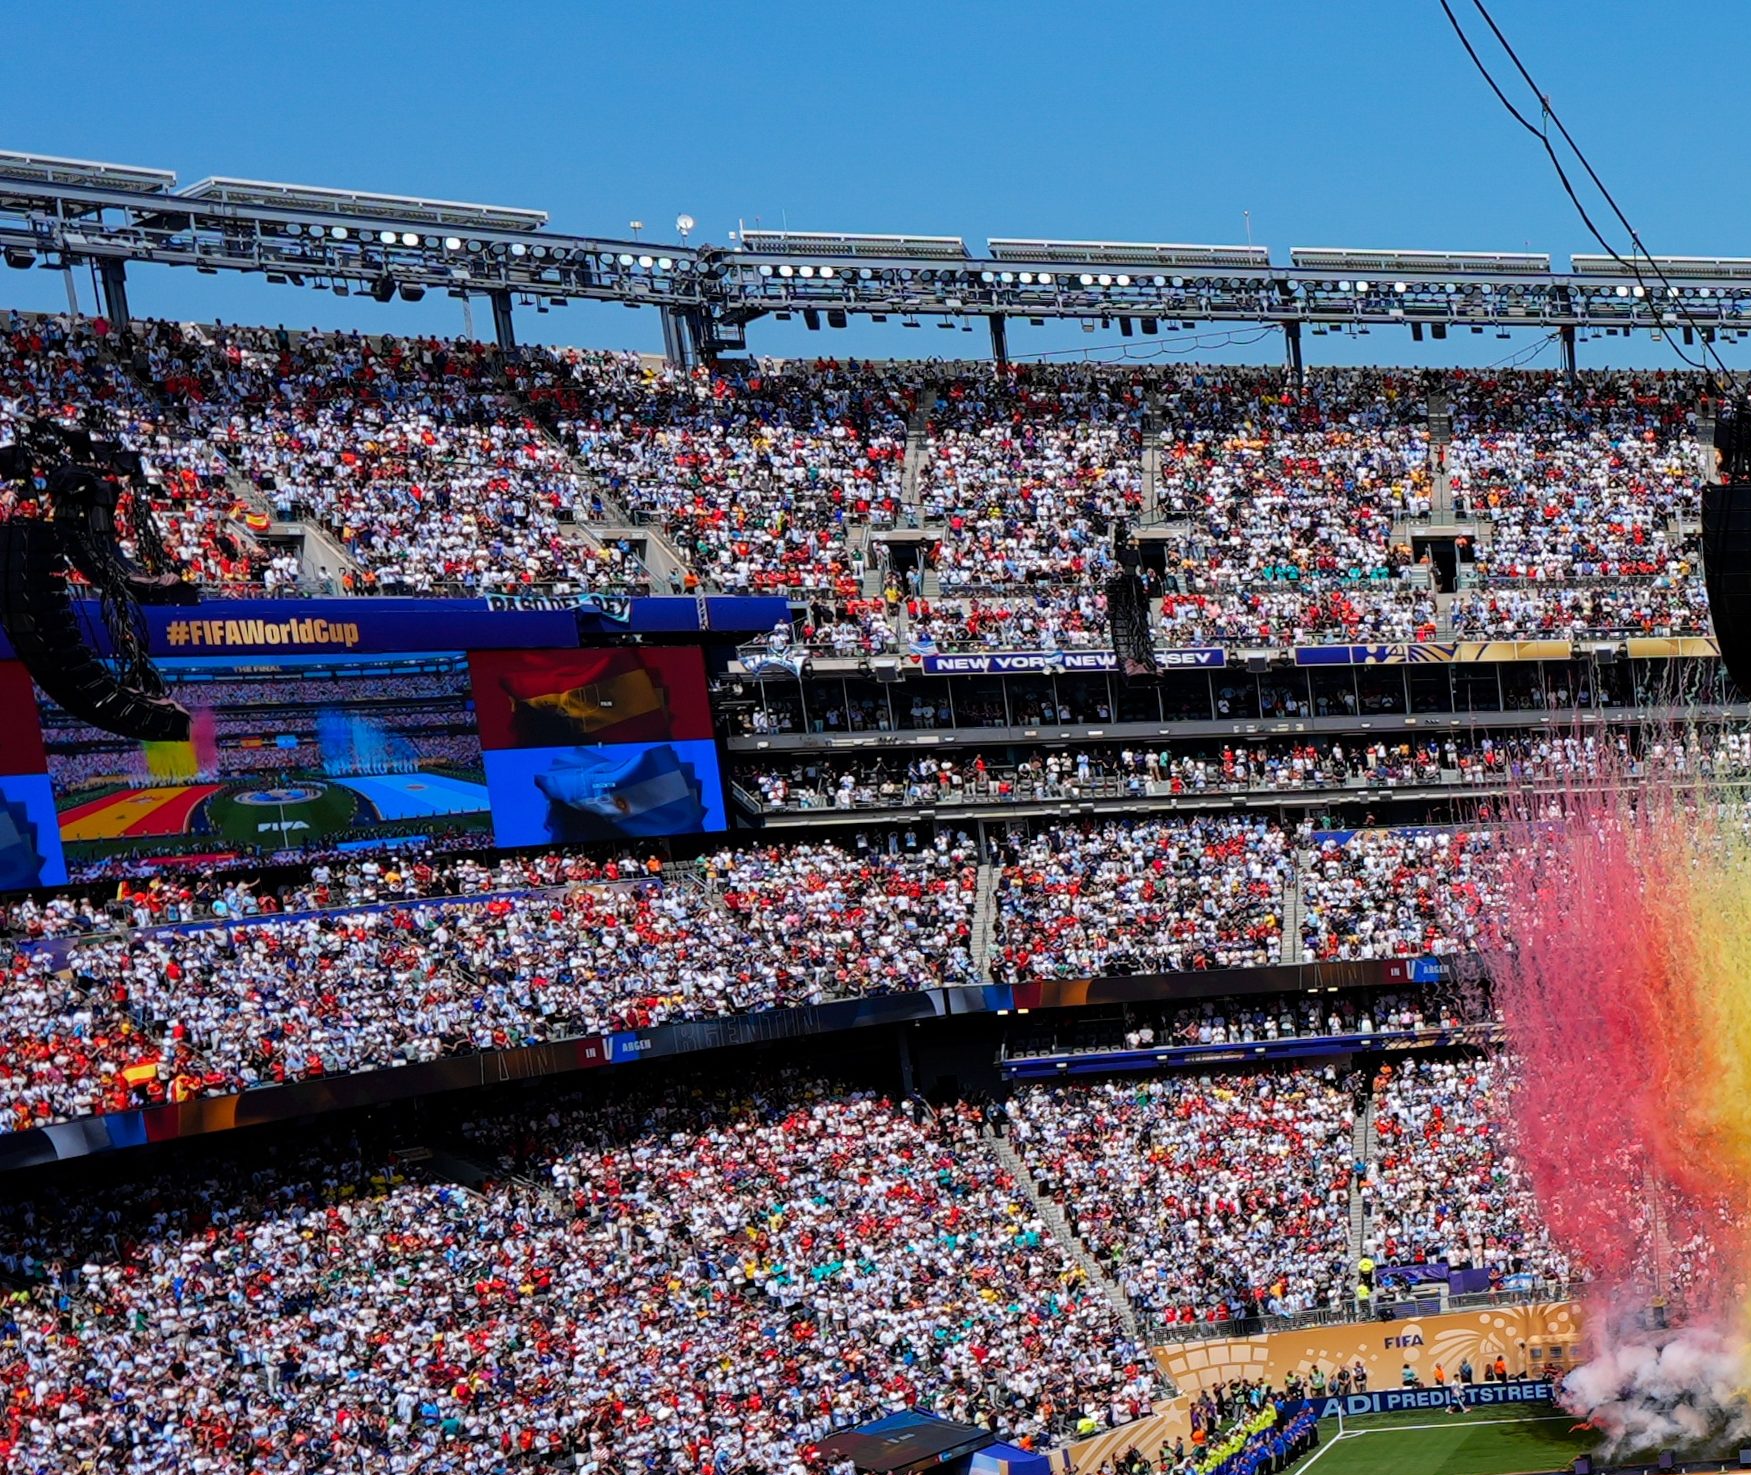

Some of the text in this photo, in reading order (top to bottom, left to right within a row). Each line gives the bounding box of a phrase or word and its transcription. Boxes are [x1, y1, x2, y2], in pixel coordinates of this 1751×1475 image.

[167, 619, 360, 648] #FIFAWorldCup
[936, 653, 1212, 671] NEW YOR NEW RSEY
[257, 821, 310, 833] FIFA
[601, 1036, 614, 1061] V
[1383, 1334, 1425, 1350] FIFA
[1320, 1384, 1559, 1418] ADI PREDITSTREET
